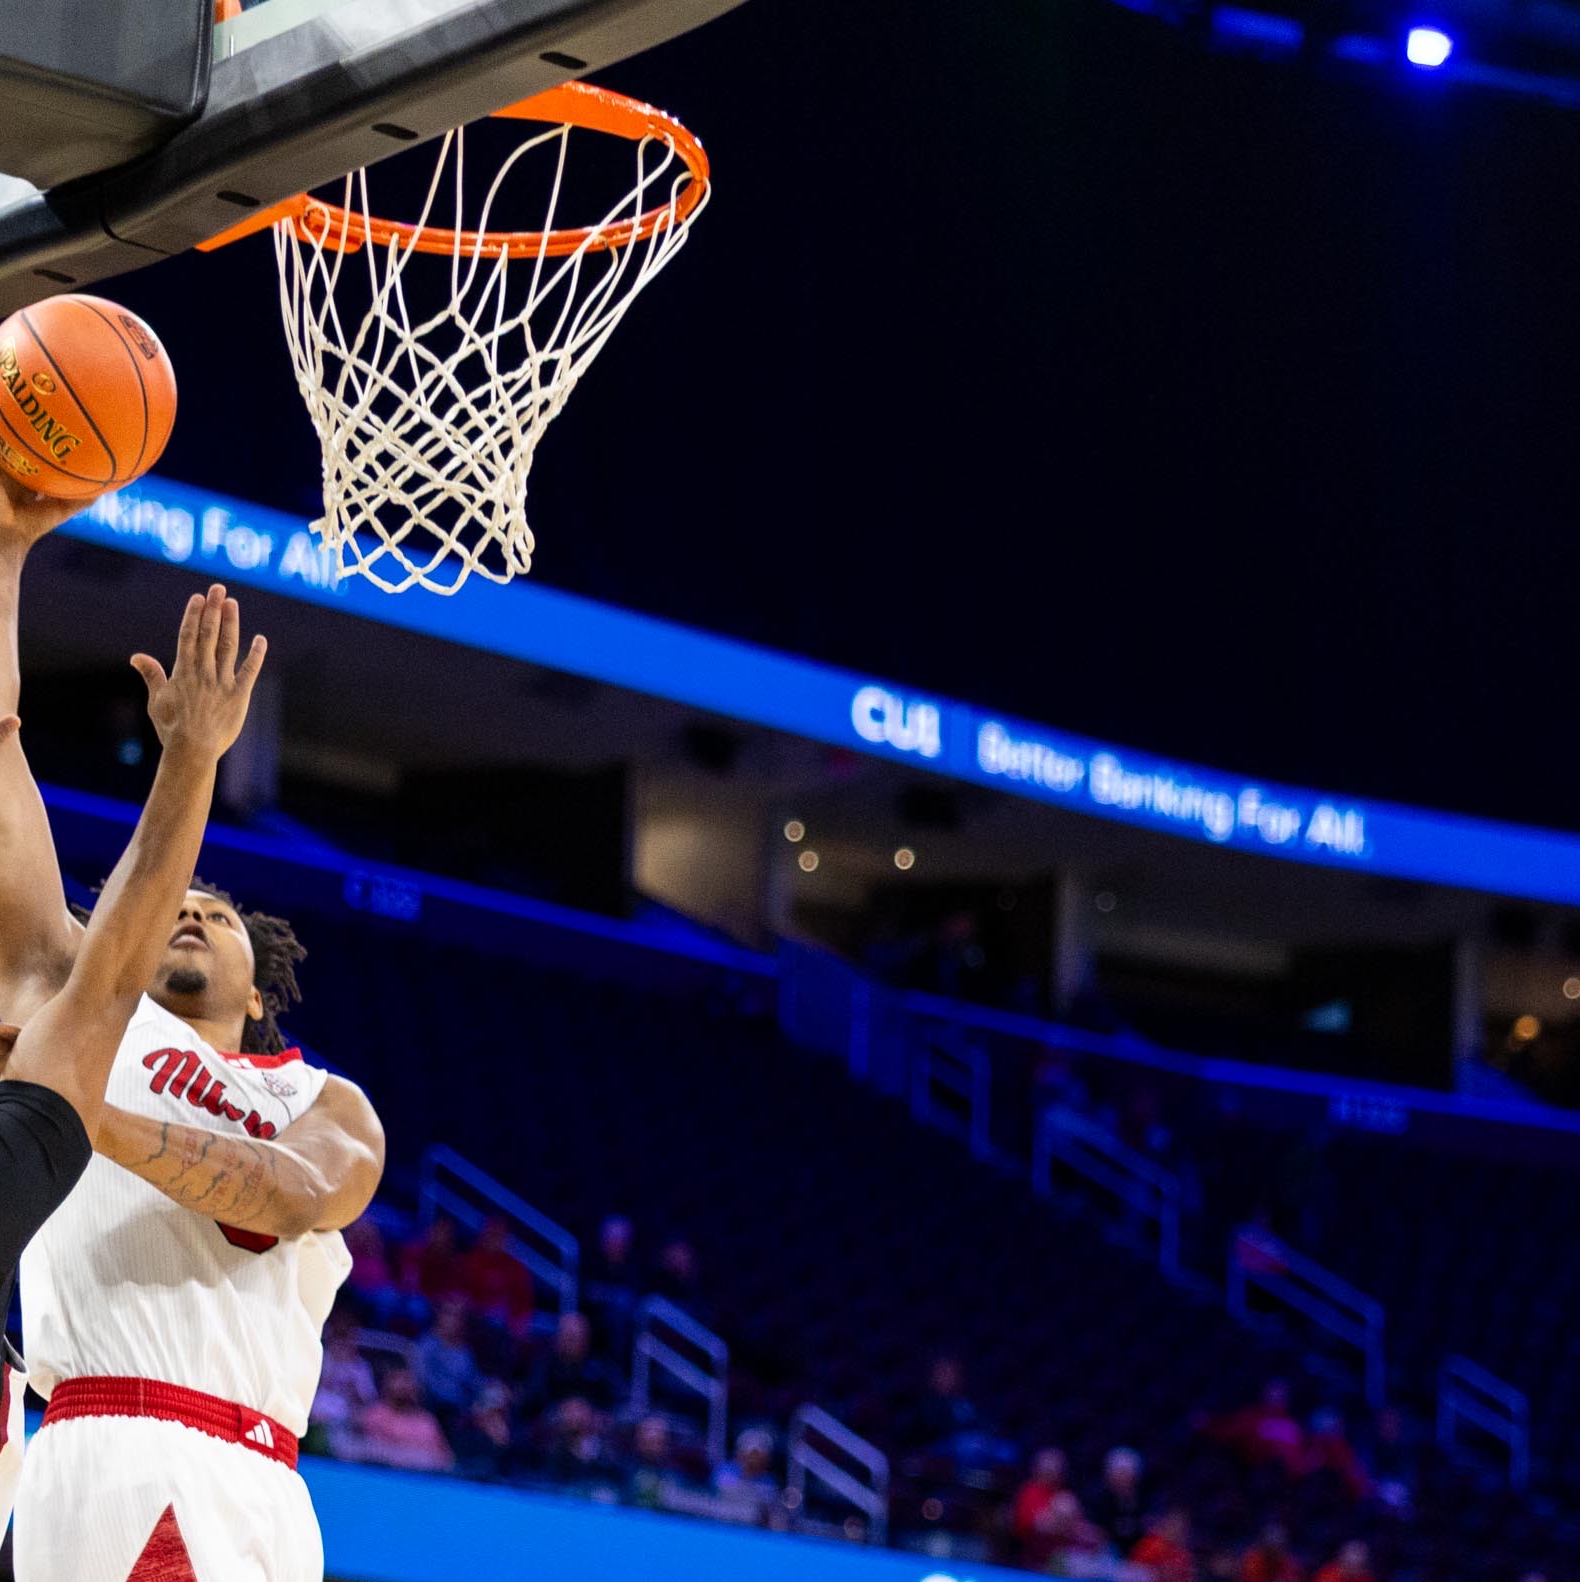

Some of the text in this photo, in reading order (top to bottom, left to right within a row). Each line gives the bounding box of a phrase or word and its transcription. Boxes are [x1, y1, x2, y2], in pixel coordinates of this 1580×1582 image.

[202, 506, 272, 570] For
[978, 721, 1085, 792] Better
[1089, 751, 1234, 841] Banking
[1238, 788, 1301, 845] For
